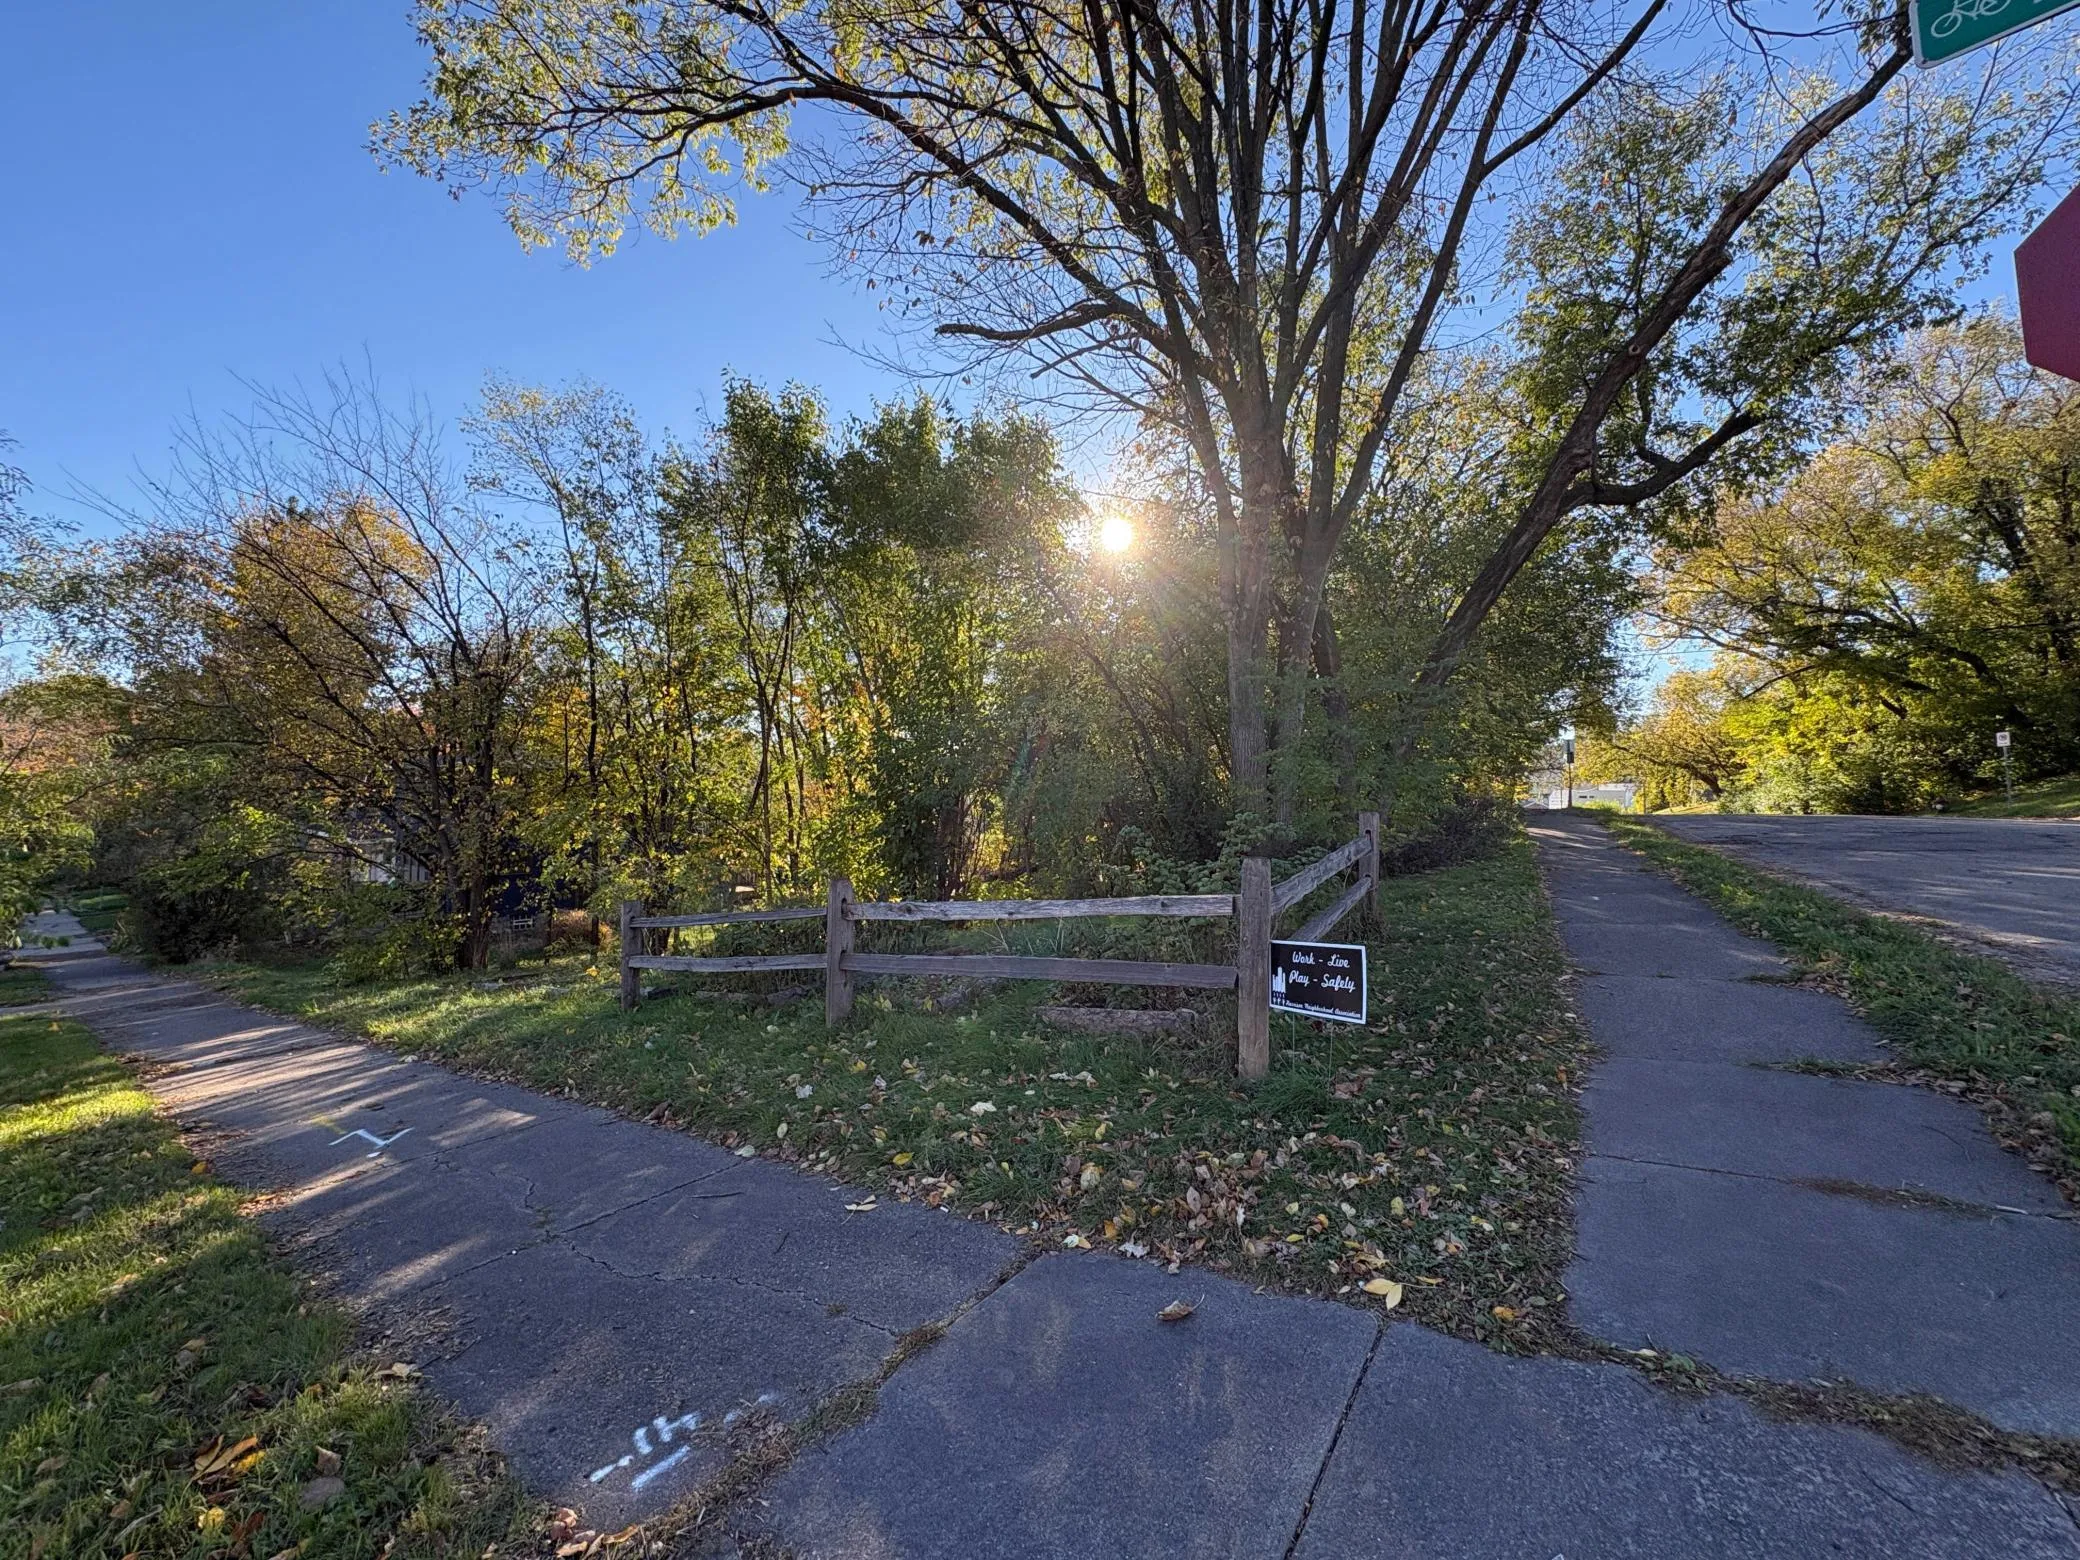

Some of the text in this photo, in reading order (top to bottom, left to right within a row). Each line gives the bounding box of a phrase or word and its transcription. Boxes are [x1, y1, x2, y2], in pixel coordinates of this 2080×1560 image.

[1292, 951, 1315, 965] Work
[1327, 953, 1350, 968] Live
[1289, 970, 1310, 987] Play
[1321, 973, 1355, 993] Safely
